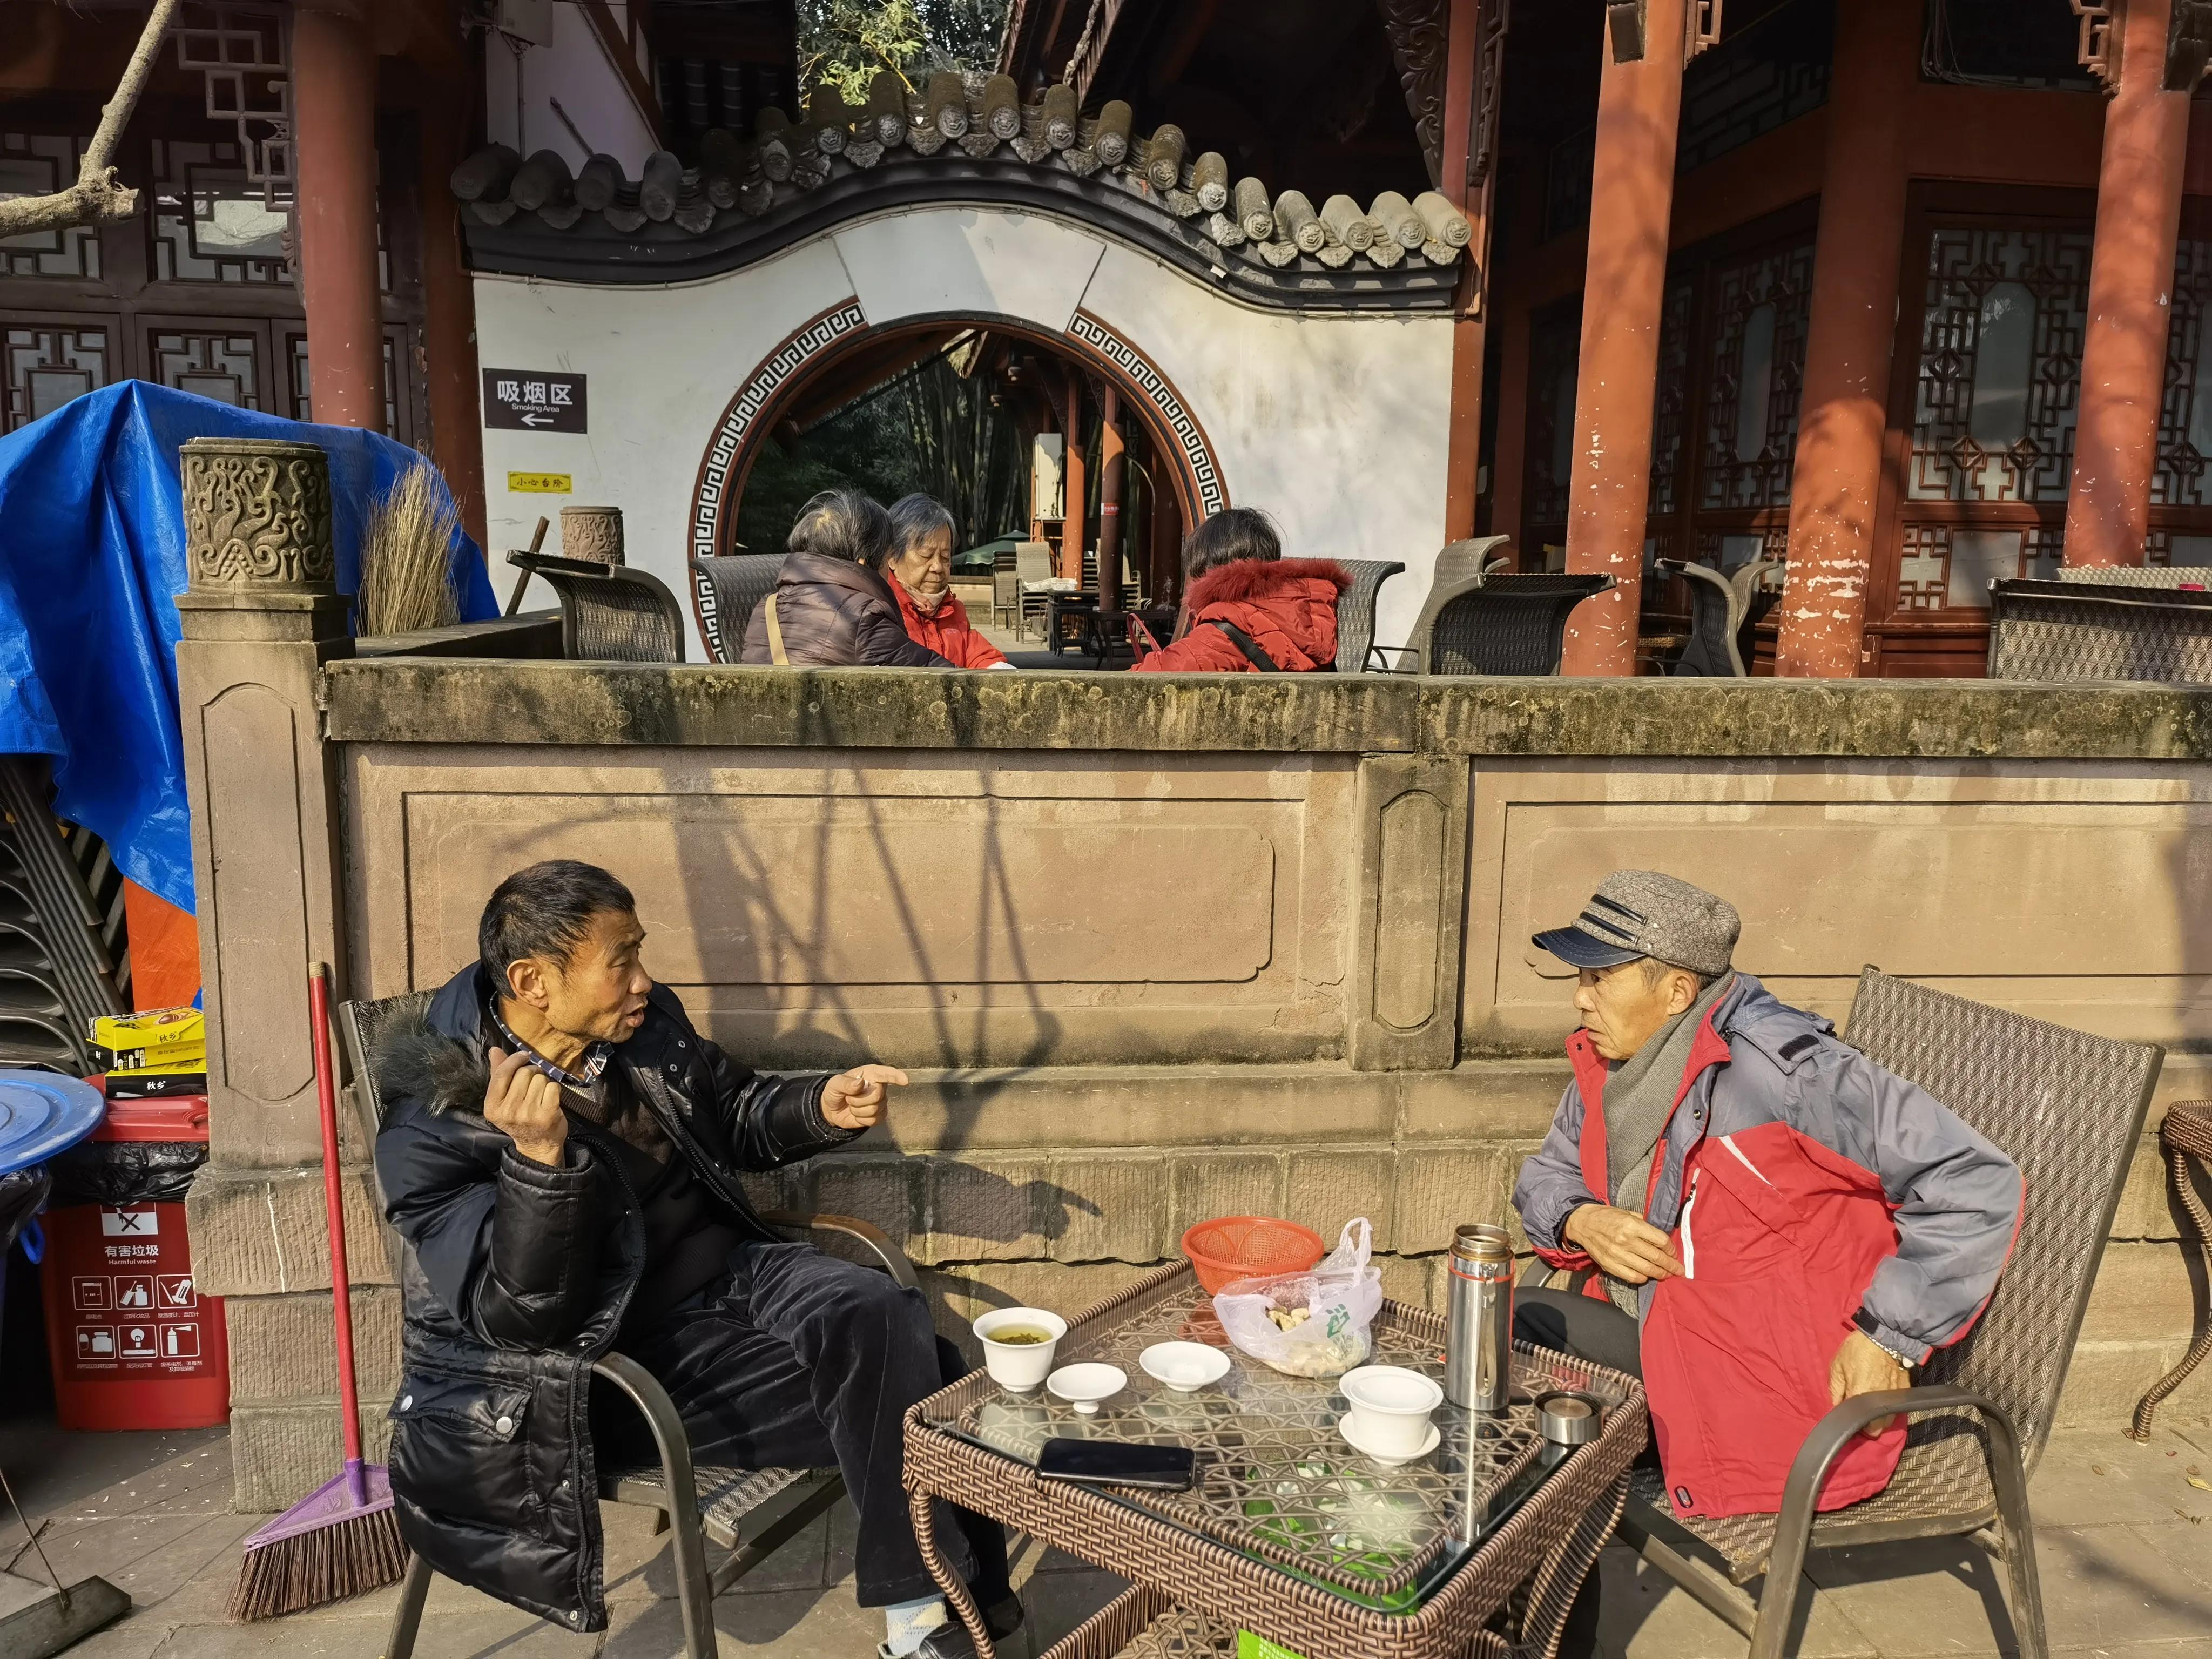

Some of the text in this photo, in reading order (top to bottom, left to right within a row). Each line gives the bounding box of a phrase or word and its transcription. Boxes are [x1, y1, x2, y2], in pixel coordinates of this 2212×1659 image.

[497, 380, 573, 405] 吸烟区
[511, 403, 560, 413] Smoking Area
[517, 477, 563, 488] 小心台阶
[147, 1081, 165, 1090] 秋乡
[104, 1245, 159, 1257] 有害垃圾
